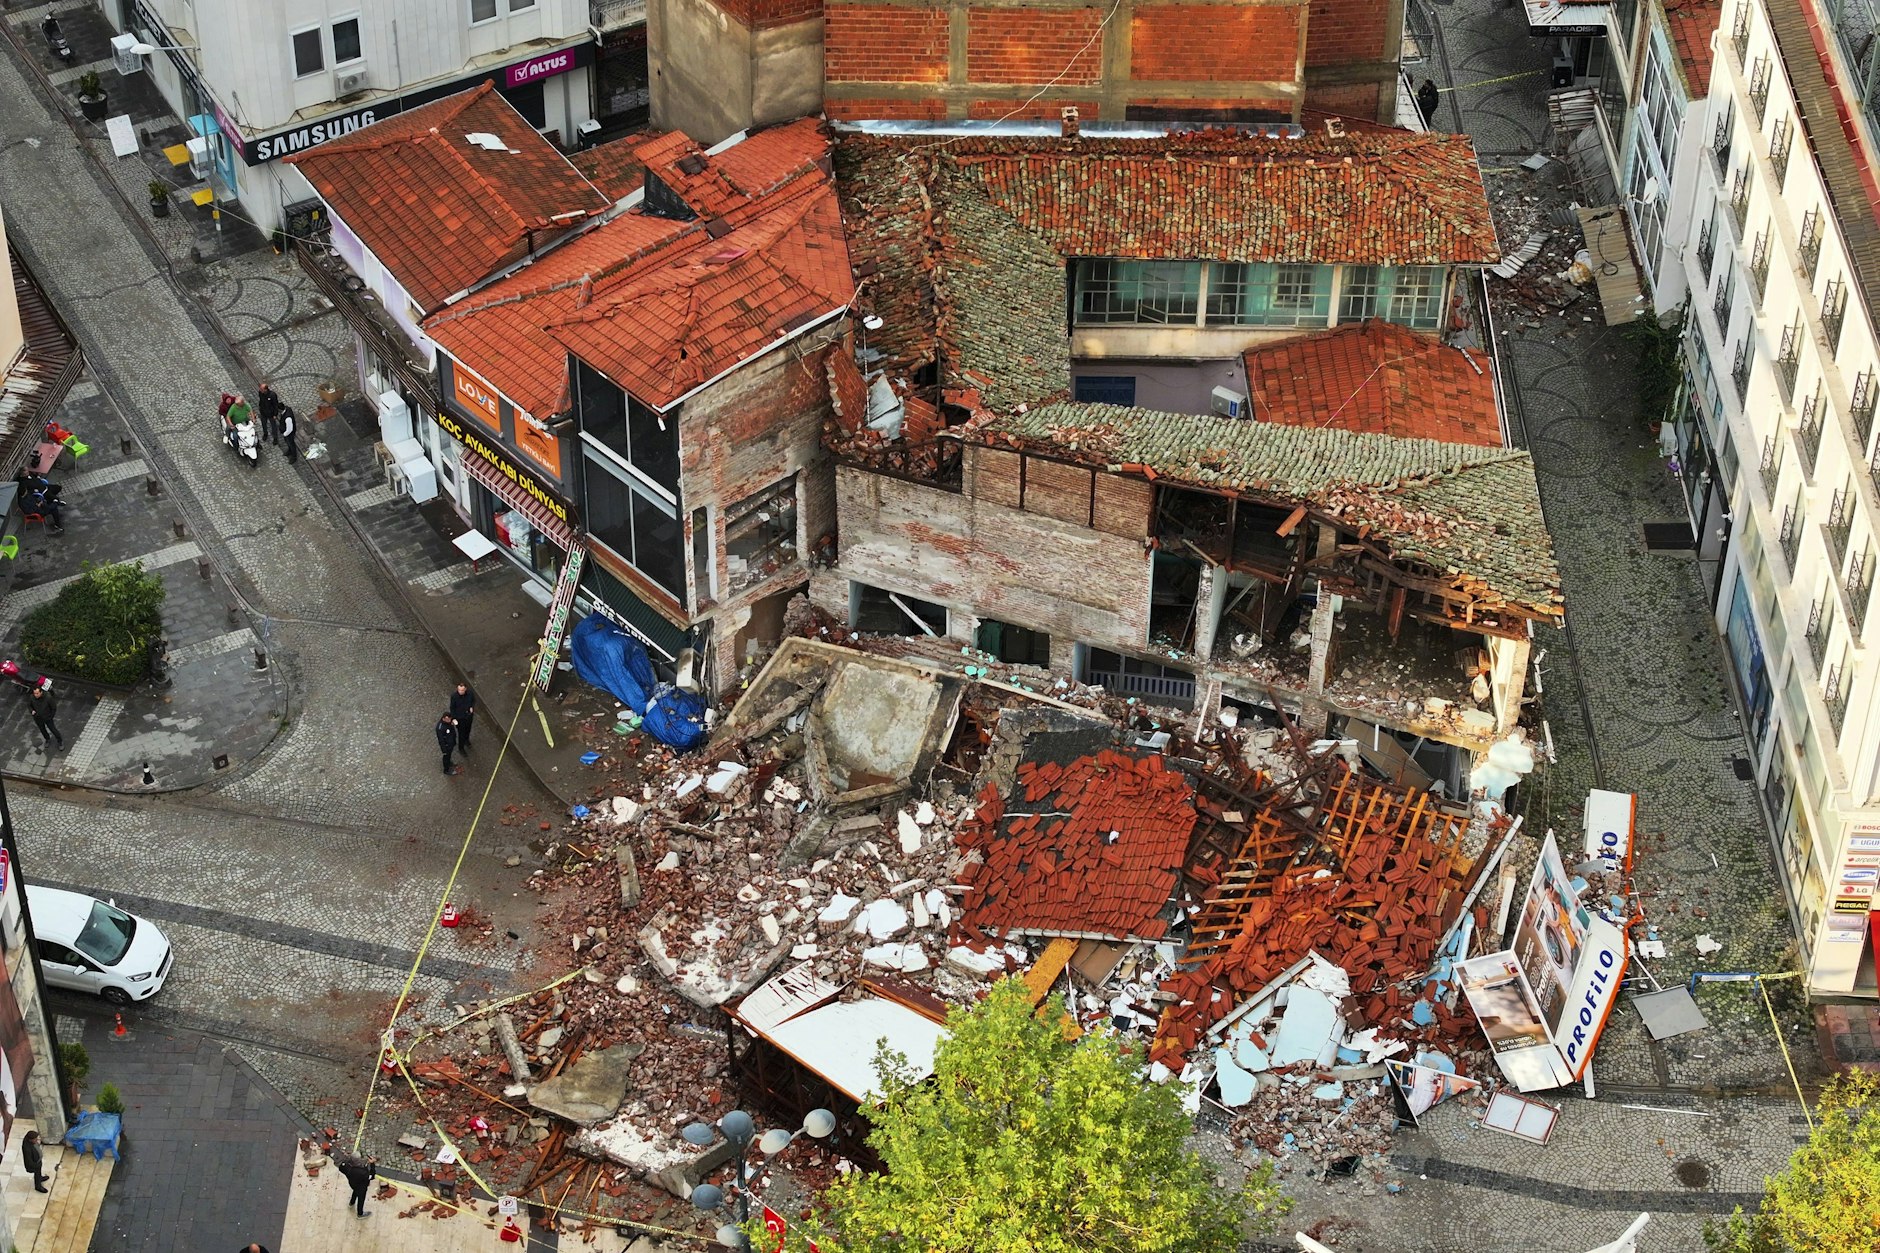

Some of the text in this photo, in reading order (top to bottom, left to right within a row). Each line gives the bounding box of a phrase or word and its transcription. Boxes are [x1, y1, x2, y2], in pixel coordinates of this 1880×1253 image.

[529, 55, 567, 76] ALTUS
[257, 110, 375, 160] SAMSUNG
[458, 377, 497, 415] LOVE
[438, 413, 463, 440] KOÇ
[464, 433, 517, 482] AYAKKABI
[519, 473, 567, 521] DÜNYASI
